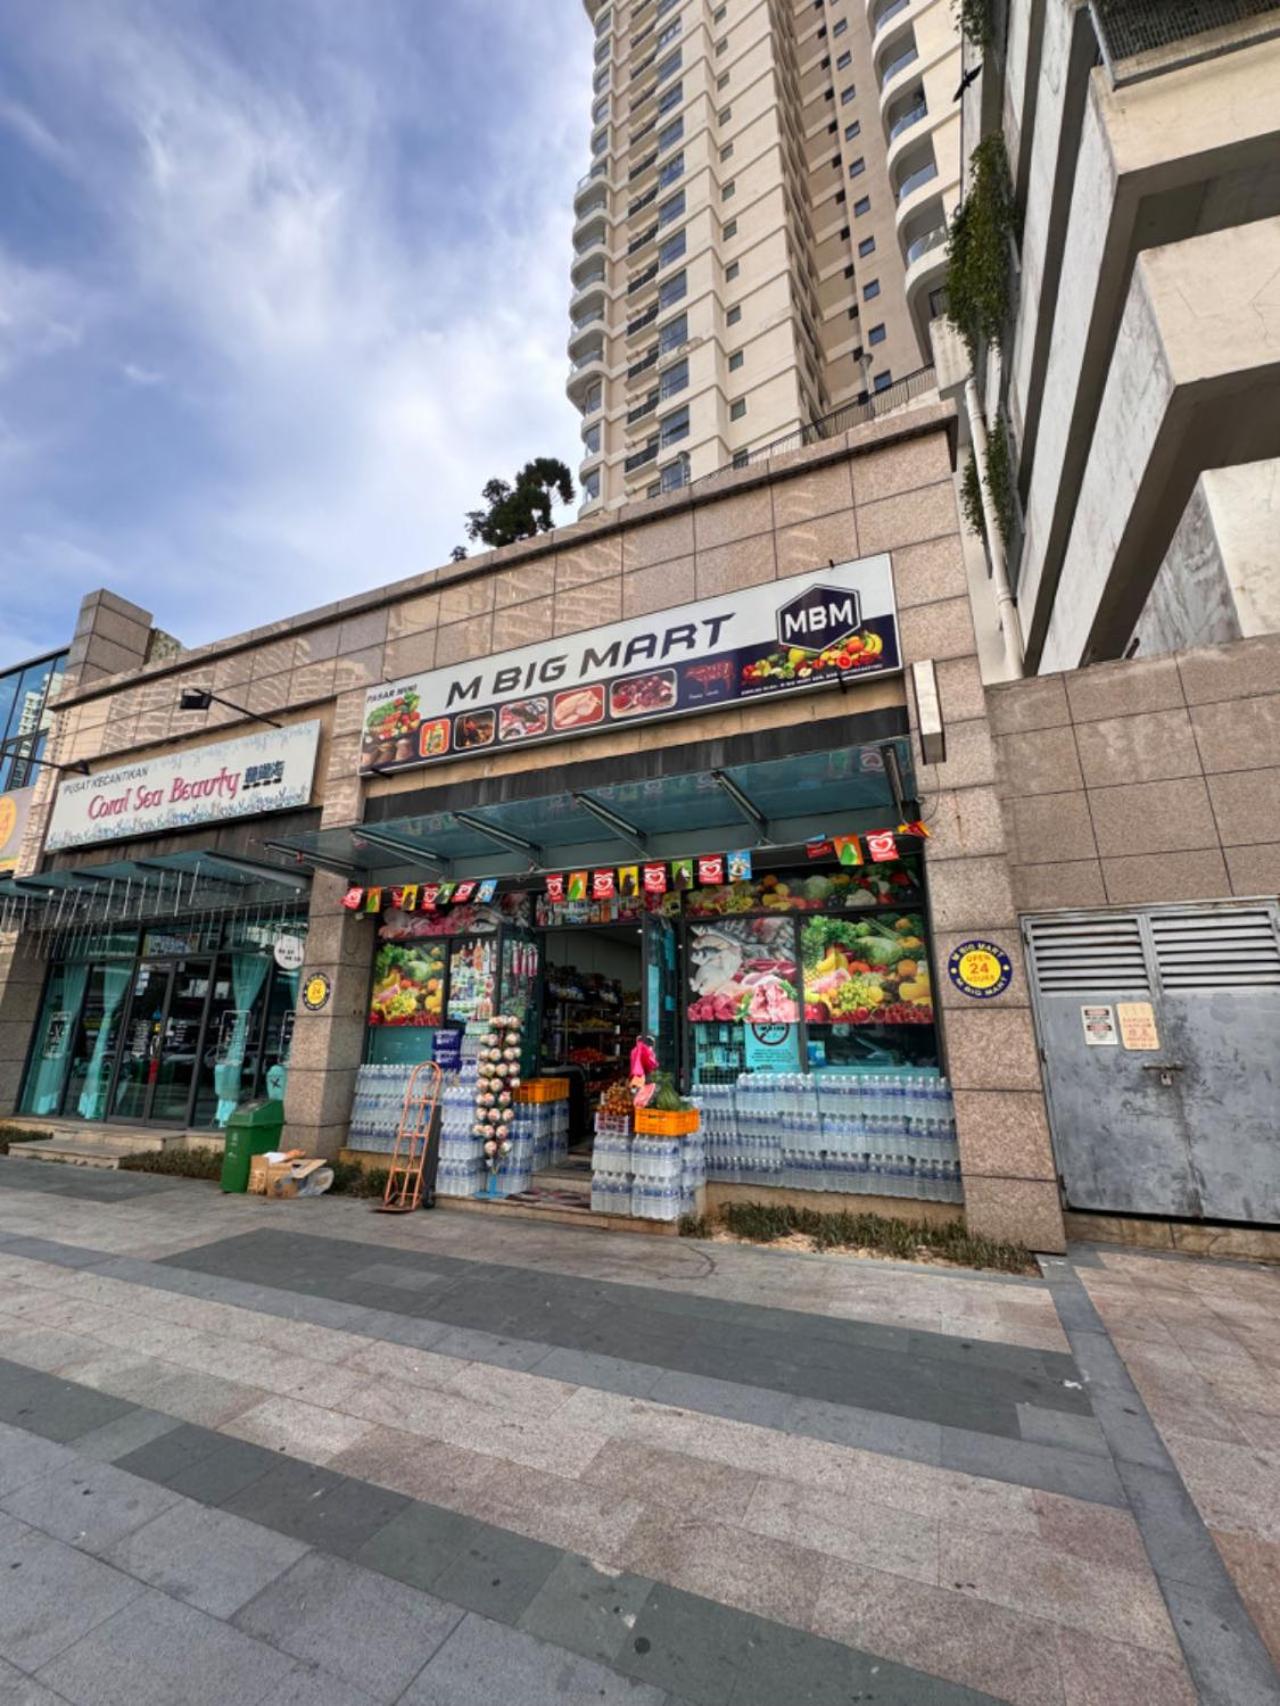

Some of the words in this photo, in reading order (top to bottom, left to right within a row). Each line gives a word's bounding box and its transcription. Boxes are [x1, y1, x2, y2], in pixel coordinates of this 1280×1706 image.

[784, 598, 854, 640] MBM
[446, 675, 483, 708] M
[492, 655, 568, 694] BIG
[579, 612, 736, 678] MART
[63, 780, 91, 795] PUSAT
[91, 767, 148, 788] KECANTIKAN
[88, 788, 132, 820] Coral
[134, 785, 164, 811] Sea
[168, 767, 241, 802] Beauty
[959, 944, 976, 954] BIG
[978, 943, 1005, 957] MART
[969, 962, 989, 974] 24
[984, 976, 1008, 995] MART
